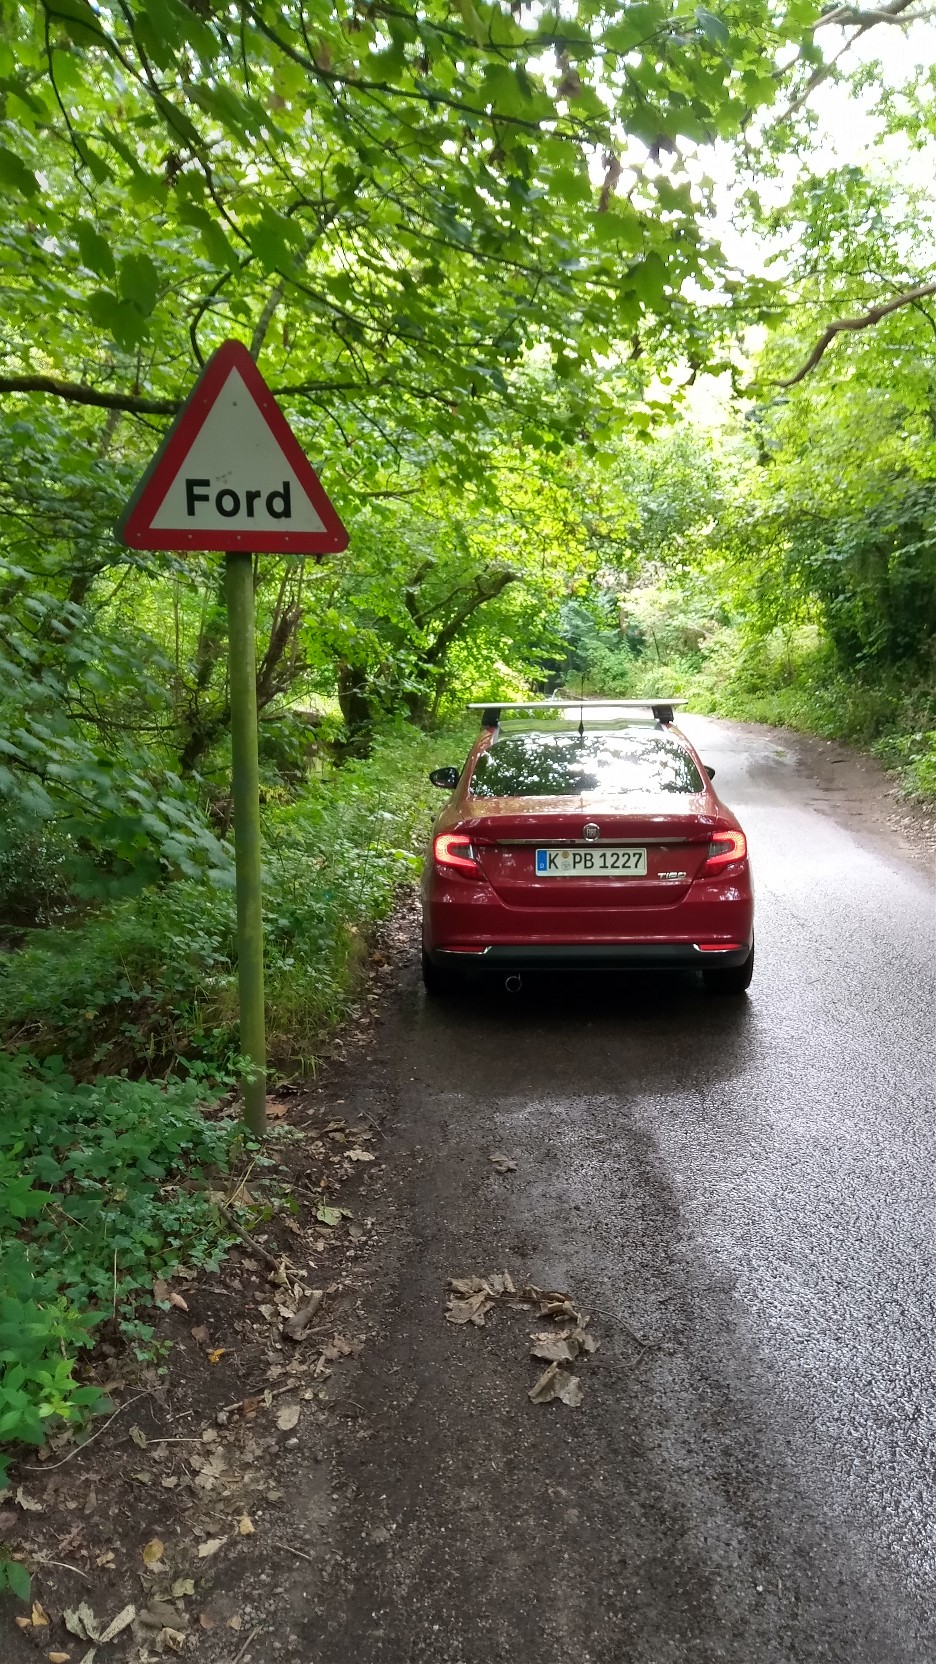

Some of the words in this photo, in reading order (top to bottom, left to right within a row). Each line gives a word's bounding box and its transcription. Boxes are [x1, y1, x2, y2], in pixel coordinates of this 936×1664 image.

[185, 478, 292, 519] Ford
[548, 852, 559, 869] K
[572, 852, 595, 869] PB
[599, 852, 643, 869] 1227
